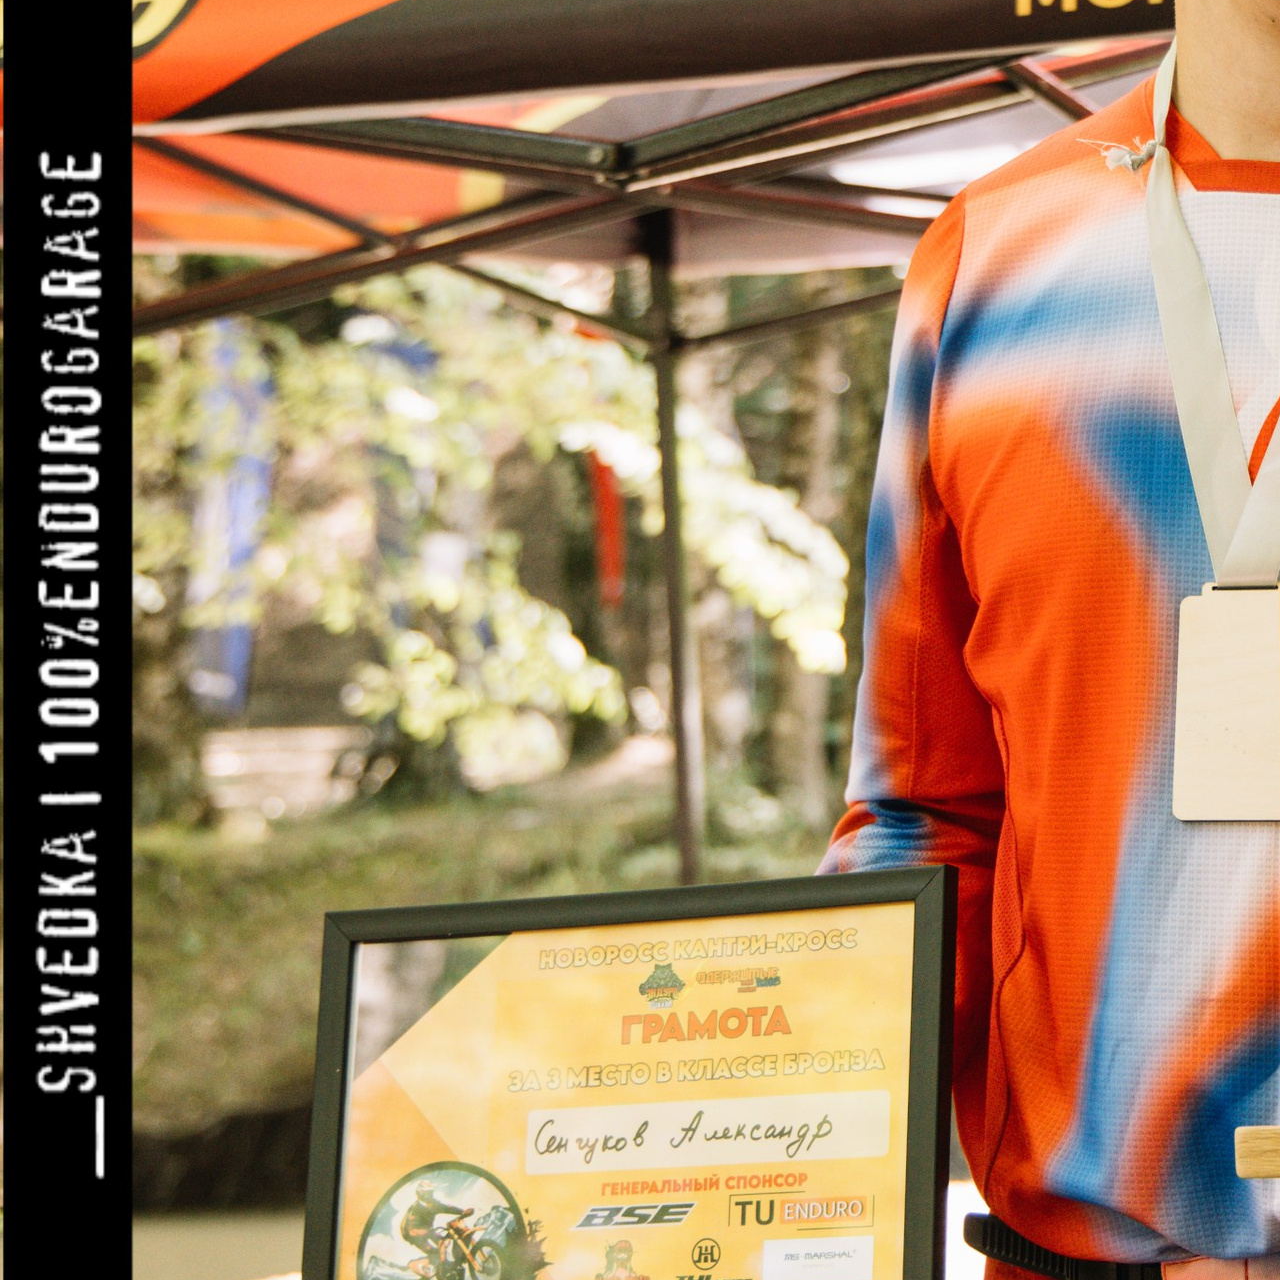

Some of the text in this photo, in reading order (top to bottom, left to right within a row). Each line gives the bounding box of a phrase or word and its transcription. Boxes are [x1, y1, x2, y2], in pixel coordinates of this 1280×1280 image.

[539, 928, 858, 969] НОВОРОСС КАНТРИ-КРОСС
[621, 1005, 792, 1045] ГРАМОТА
[508, 1049, 885, 1093] ЗА 3 МЕСТО В КЛАССЕ БРОНЗА
[670, 1110, 833, 1158] Александр
[601, 1172, 809, 1196] ГЕНЕРАЛЬНЫЙ СПОНСОР
[573, 1202, 697, 1230] BSE
[734, 1200, 864, 1226] TU ENDURO
